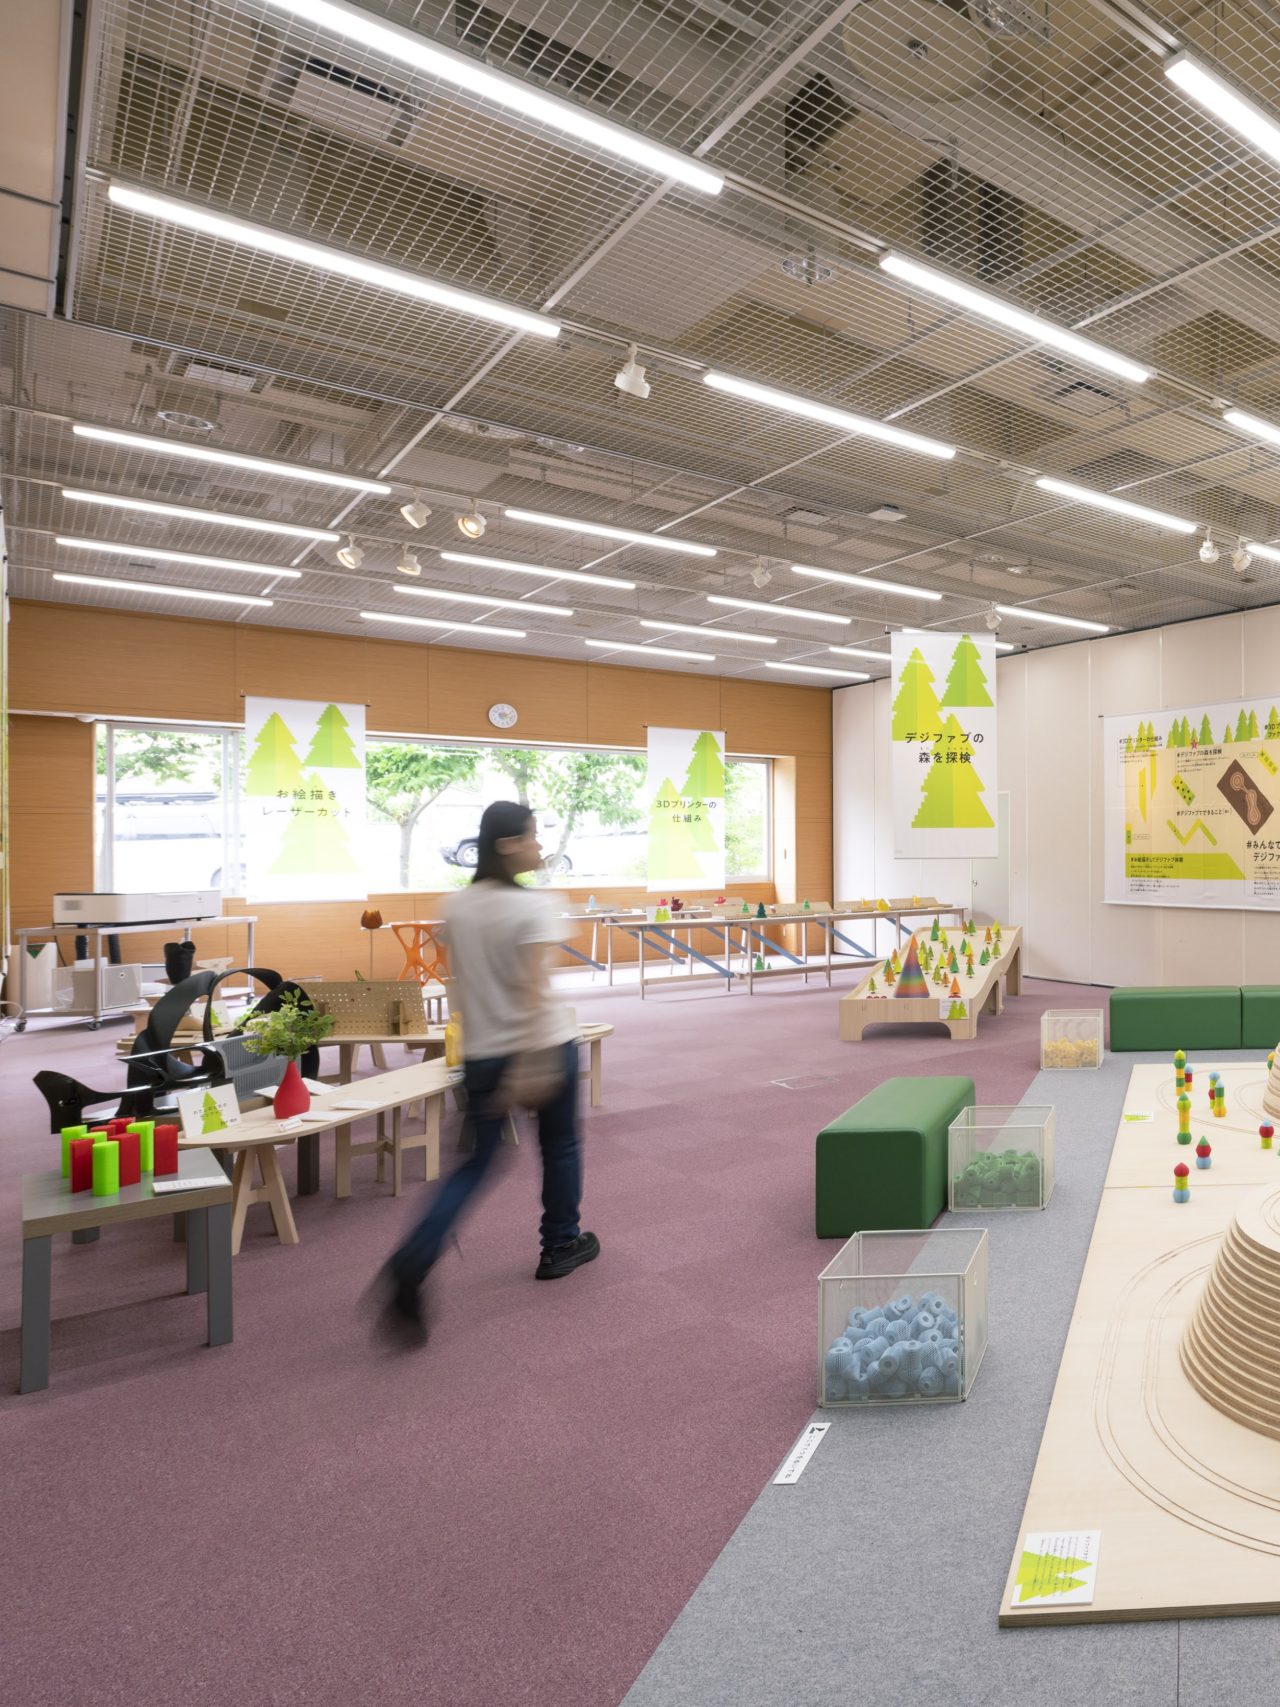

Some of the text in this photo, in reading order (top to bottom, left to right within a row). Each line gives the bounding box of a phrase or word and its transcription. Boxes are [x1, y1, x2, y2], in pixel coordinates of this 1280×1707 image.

[904, 731, 985, 744] デジファブの
[918, 751, 972, 764] 森を探検
[275, 788, 337, 801] お絵描き
[656, 799, 718, 809] 3Dプリンターの
[261, 806, 352, 818] レーザーカット
[672, 813, 702, 823] 仕組み
